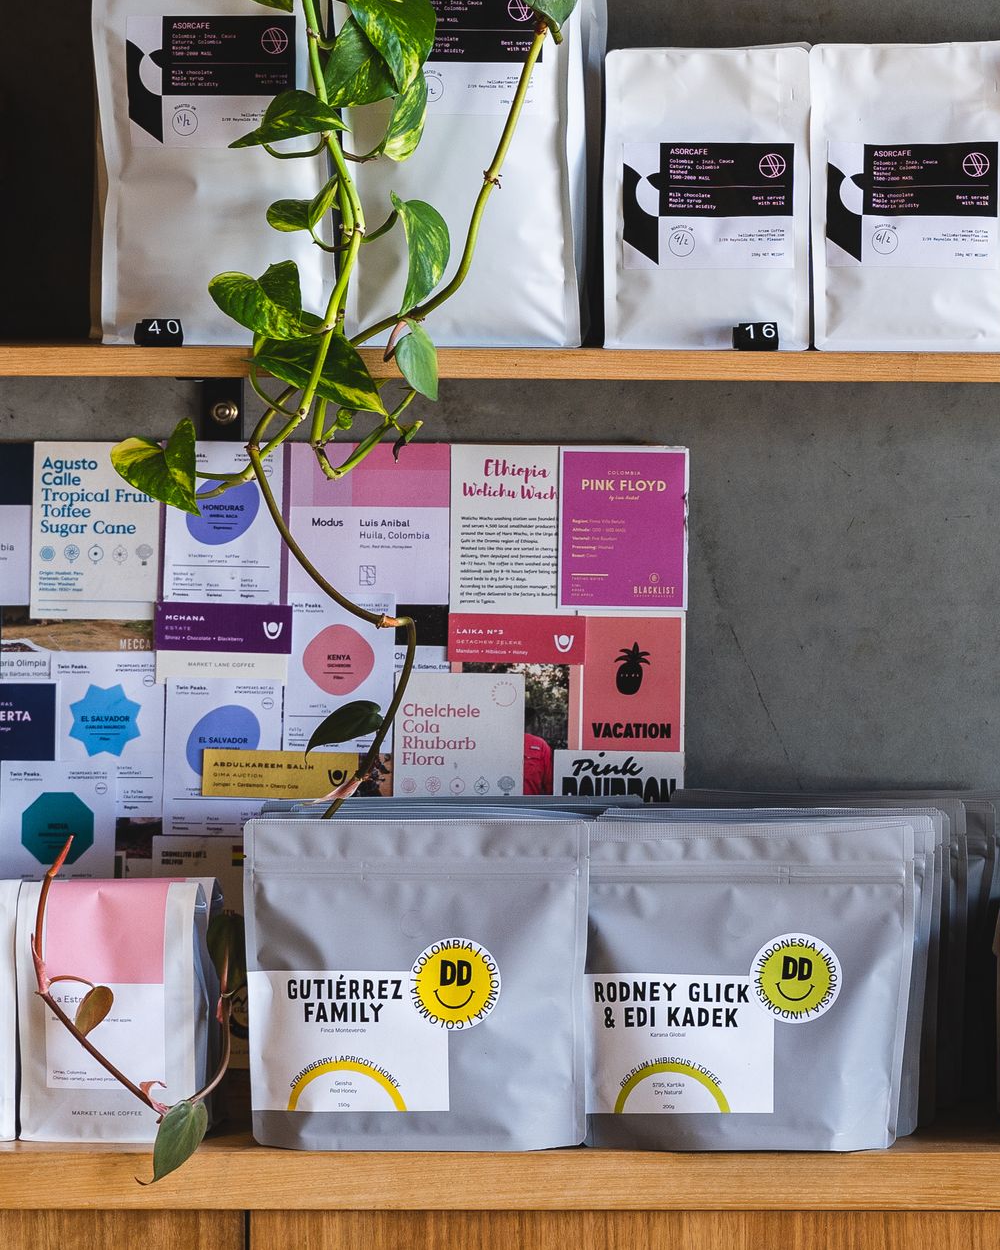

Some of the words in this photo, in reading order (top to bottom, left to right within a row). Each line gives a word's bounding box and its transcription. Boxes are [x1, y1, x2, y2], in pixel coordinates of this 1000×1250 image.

[172, 22, 210, 30] ASORCAFE
[670, 148, 708, 156] ASORCAFE
[745, 323, 776, 340] 16
[42, 457, 98, 473] Agusto
[484, 458, 551, 484] Ethiopia
[42, 472, 81, 486] Calle
[581, 479, 615, 491] PINK
[620, 479, 667, 492] FLOYD
[42, 488, 110, 507] Tropical
[462, 482, 518, 499] Wolichu
[41, 504, 91, 518] Toffee
[202, 504, 245, 512] HONDURAS
[40, 520, 87, 537] Sugar
[93, 520, 136, 535] Cane
[311, 518, 344, 527] Modus
[359, 519, 379, 527] Luis
[381, 519, 410, 528] Anibal
[359, 531, 385, 540] Huila,
[388, 531, 430, 540] Colombia
[633, 586, 675, 595] BLACKLIST
[165, 614, 205, 622] MCHANA
[16, 659, 47, 668] Olimpia
[81, 715, 90, 723] EL
[91, 715, 130, 723] SALVADOR
[402, 704, 481, 718] Chelchele
[402, 719, 440, 734] Cola
[592, 722, 672, 739] VACATION
[198, 736, 207, 744] EL
[208, 736, 248, 744] SALVADOR
[402, 736, 476, 750] Rhubarb
[213, 761, 283, 769] ABDULKAREEM
[402, 752, 444, 766] Flora
[572, 751, 644, 776] Pink
[412, 939, 474, 975] COLOMBIA
[757, 937, 816, 968] INDONESIA
[440, 959, 473, 987] DD
[781, 955, 813, 981] DD
[287, 974, 403, 1000] GUTIÉRREZ
[474, 953, 500, 1021] COLOMBIA
[594, 981, 677, 1003] RODNEY
[688, 982, 750, 1003] GLICK
[811, 953, 838, 1014] INDONESIA
[755, 977, 802, 1020] INDONESIA
[304, 1002, 384, 1023] FAMILY
[410, 986, 465, 1030] COLOMBIA
[604, 1006, 615, 1028] &
[624, 1006, 656, 1028] EDI
[667, 1006, 738, 1028] KADEK
[290, 1055, 334, 1090] STRAWBERRY
[339, 1055, 374, 1068] APRICOT
[379, 1066, 401, 1090] HONEY
[619, 1073, 631, 1088] RED
[630, 1060, 650, 1077] PLUM
[654, 1056, 692, 1067] HIBISCUS
[697, 1063, 723, 1087] TOFFEE
